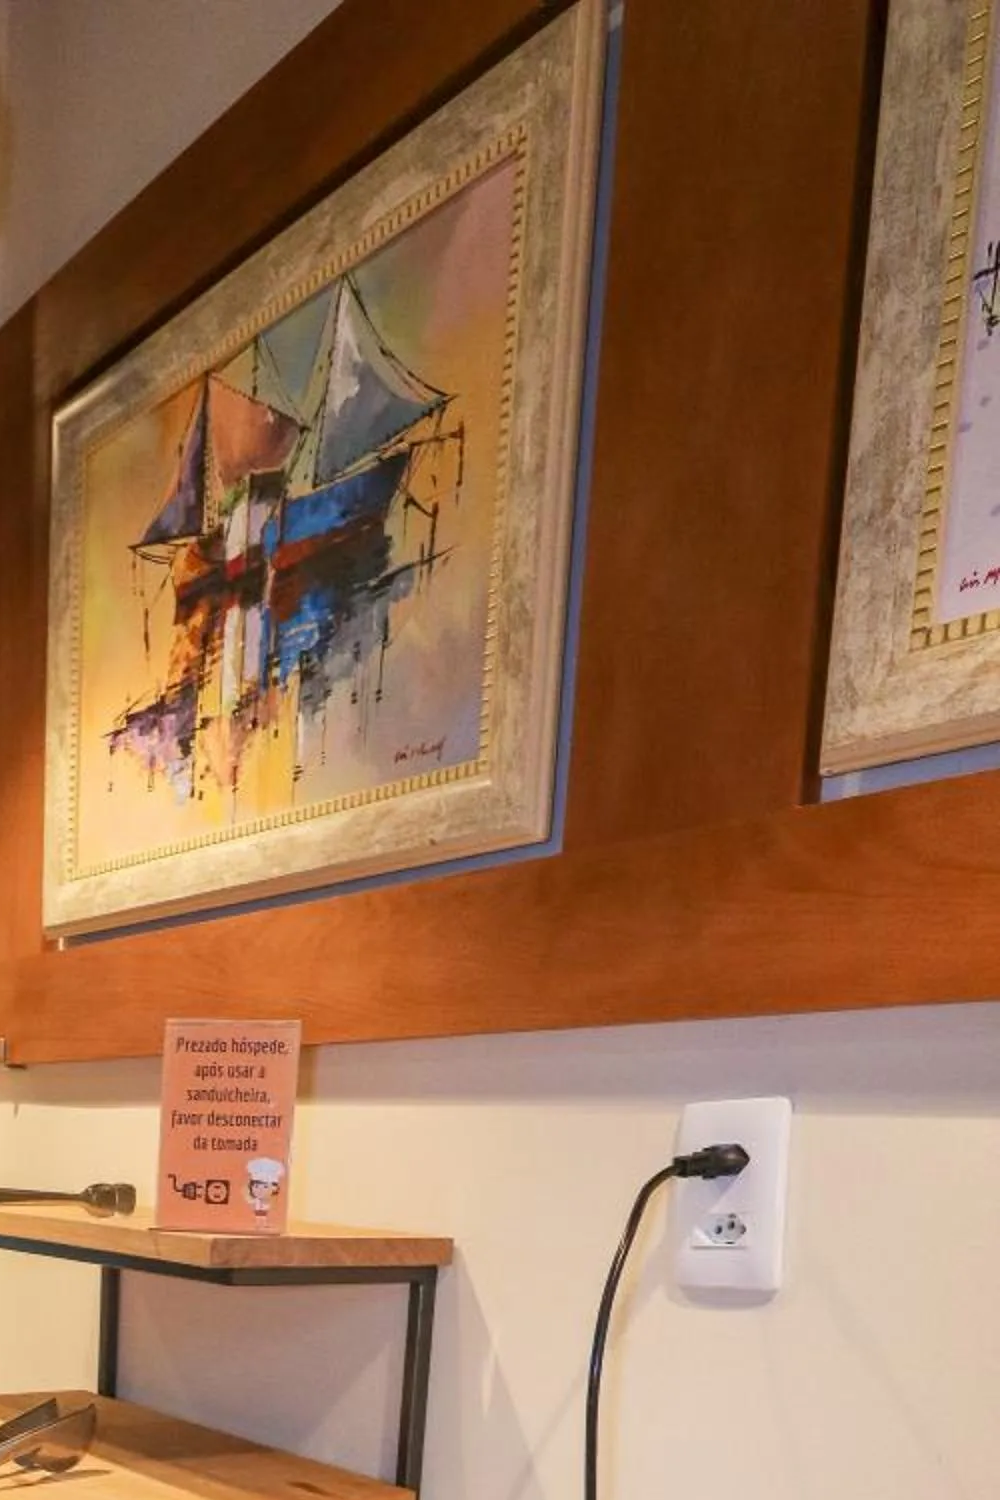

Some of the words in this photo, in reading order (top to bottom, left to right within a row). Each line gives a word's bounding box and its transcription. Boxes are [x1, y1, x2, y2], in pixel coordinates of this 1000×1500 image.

[176, 1037, 227, 1053] Prezado
[195, 1062, 223, 1081] após
[227, 1064, 255, 1079] usar
[258, 1066, 266, 1079] a
[186, 1087, 271, 1104] sanduicheira,
[171, 1110, 203, 1128] favor
[207, 1110, 282, 1128] desconectar
[193, 1136, 208, 1151] da
[211, 1136, 258, 1151] tomada
